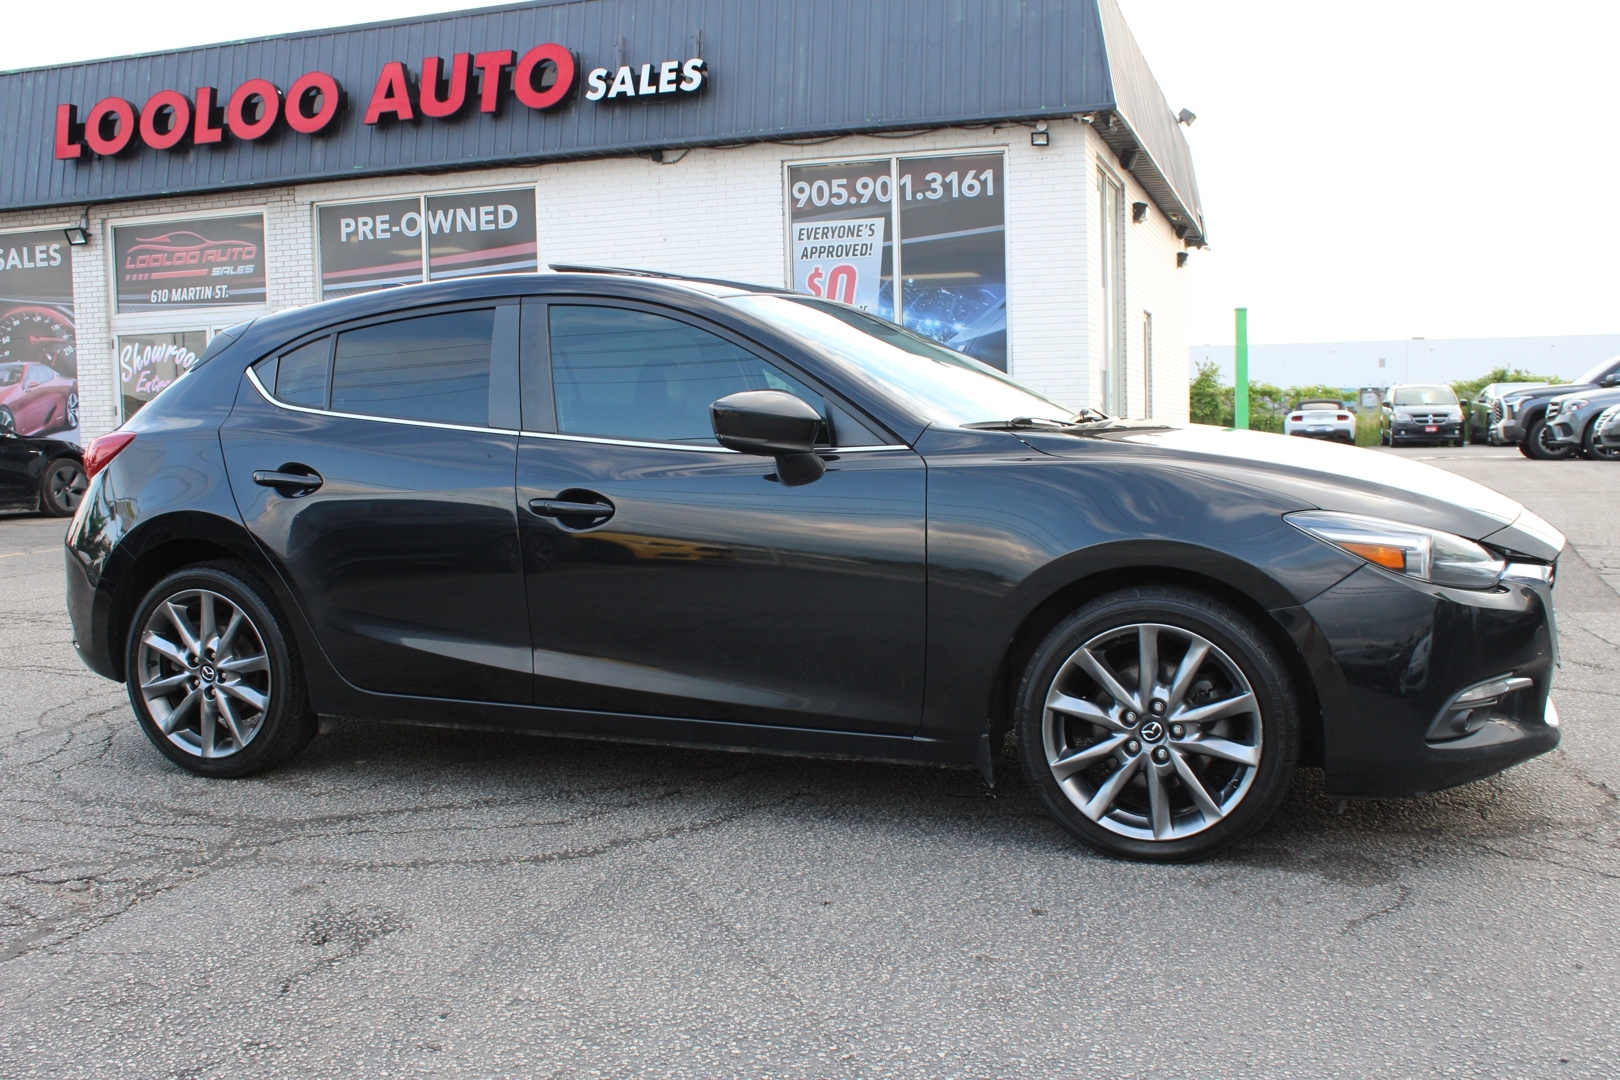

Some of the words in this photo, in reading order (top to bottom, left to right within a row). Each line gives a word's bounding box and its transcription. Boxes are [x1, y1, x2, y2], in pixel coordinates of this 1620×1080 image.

[55, 71, 342, 160] LOOLOO
[363, 43, 577, 126] AUTO
[586, 58, 706, 101] SALES
[792, 168, 995, 209] 905.901.3161
[340, 204, 519, 242] PRE-OWNED
[797, 223, 876, 242] EVERYONE'S
[125, 250, 201, 270] LOOLOO
[202, 246, 257, 263] AUTO
[800, 242, 874, 260] APPROVED!
[211, 264, 255, 277] SALES
[150, 289, 169, 303] 610
[171, 286, 212, 302] MARTIN
[214, 284, 229, 299] ST.
[120, 342, 200, 382] Showroo
